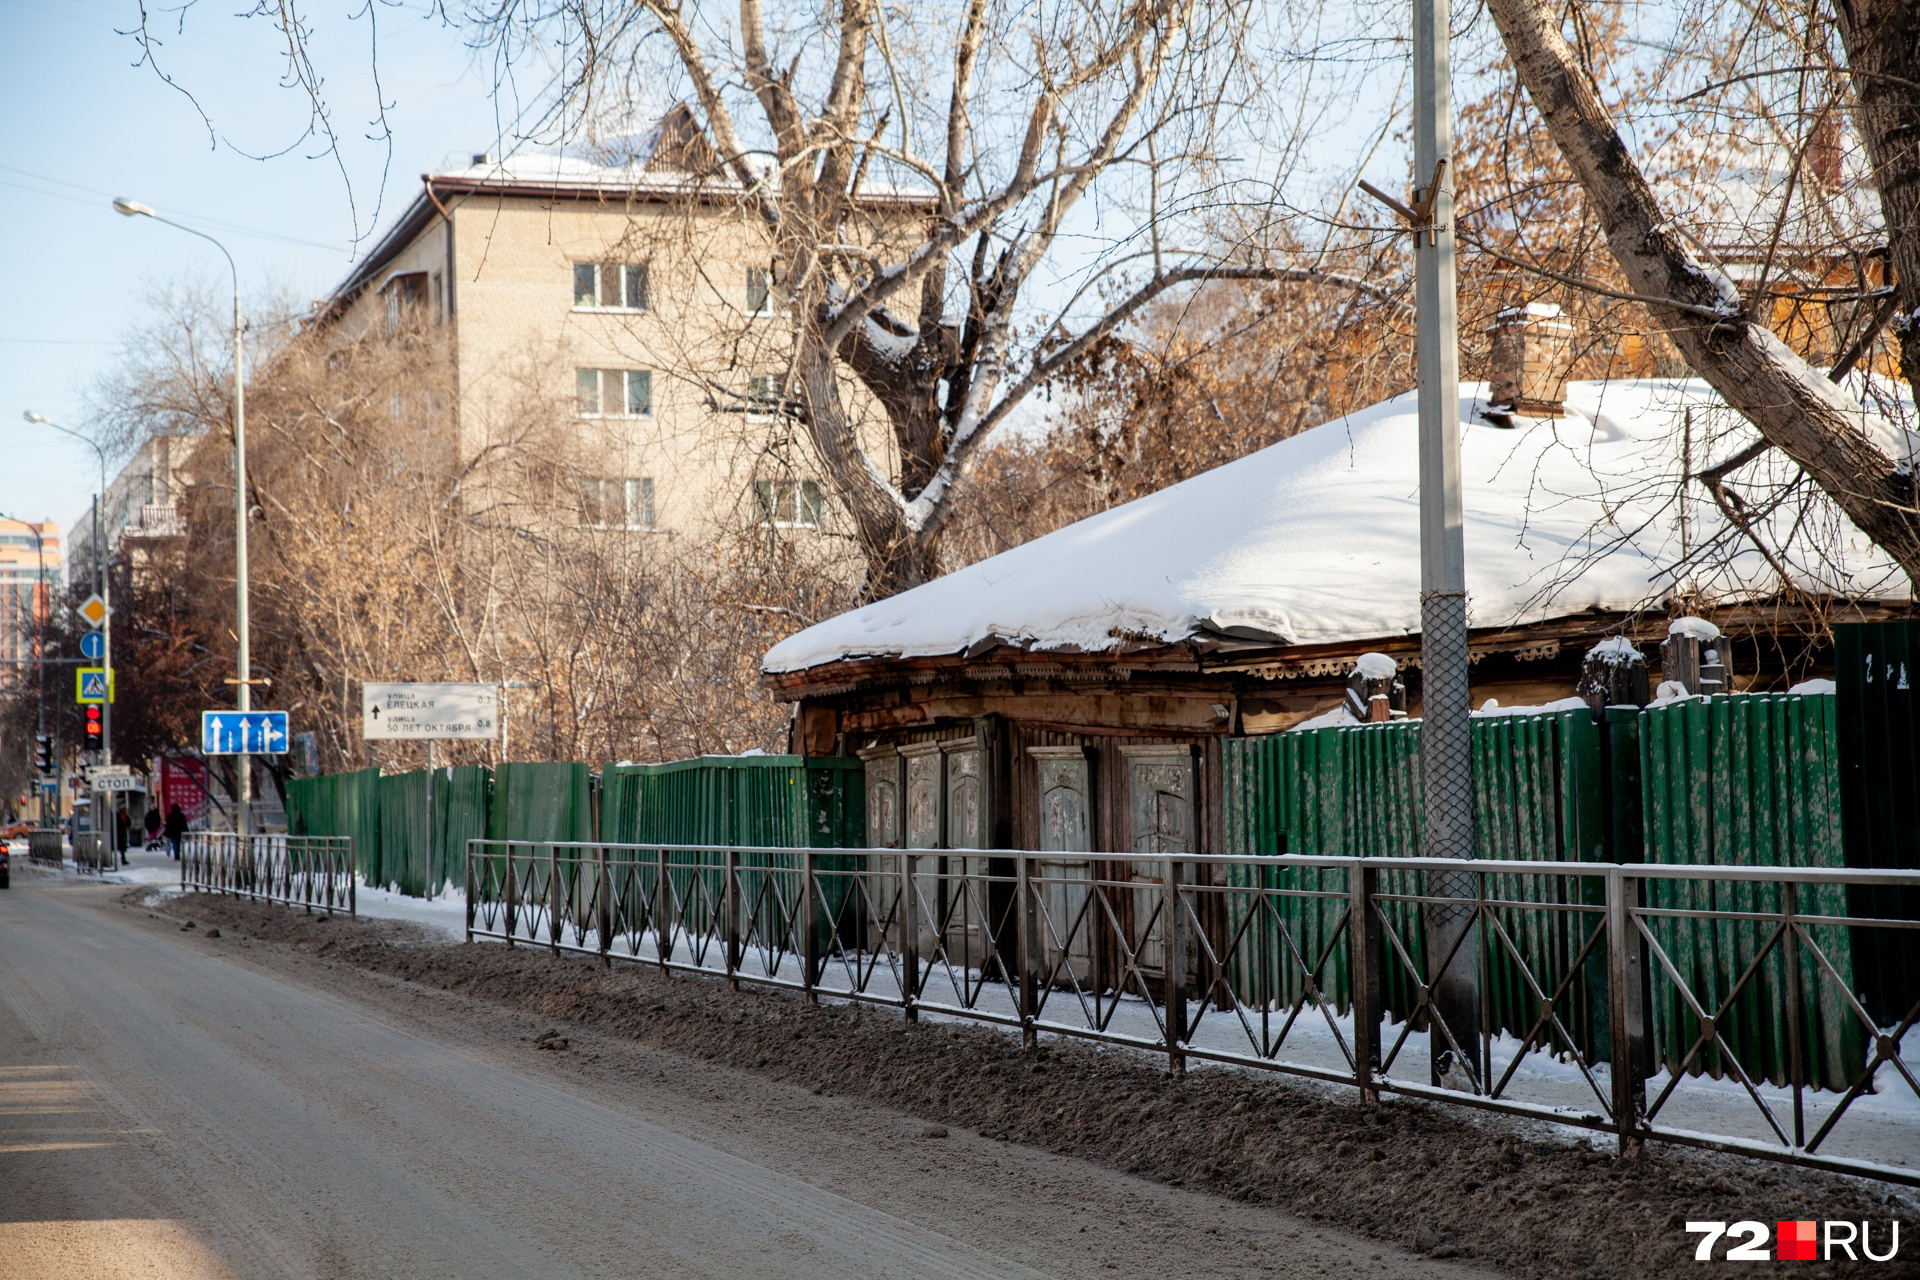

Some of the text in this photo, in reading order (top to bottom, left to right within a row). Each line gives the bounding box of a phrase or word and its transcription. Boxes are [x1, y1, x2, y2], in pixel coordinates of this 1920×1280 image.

[387, 701, 435, 709] ЕЛЕЦКАЯ
[477, 719, 491, 728] 0.8
[387, 724, 472, 732] 50 ЛЕТ ОКТЯБРЯ
[98, 778, 130, 789] СТОП
